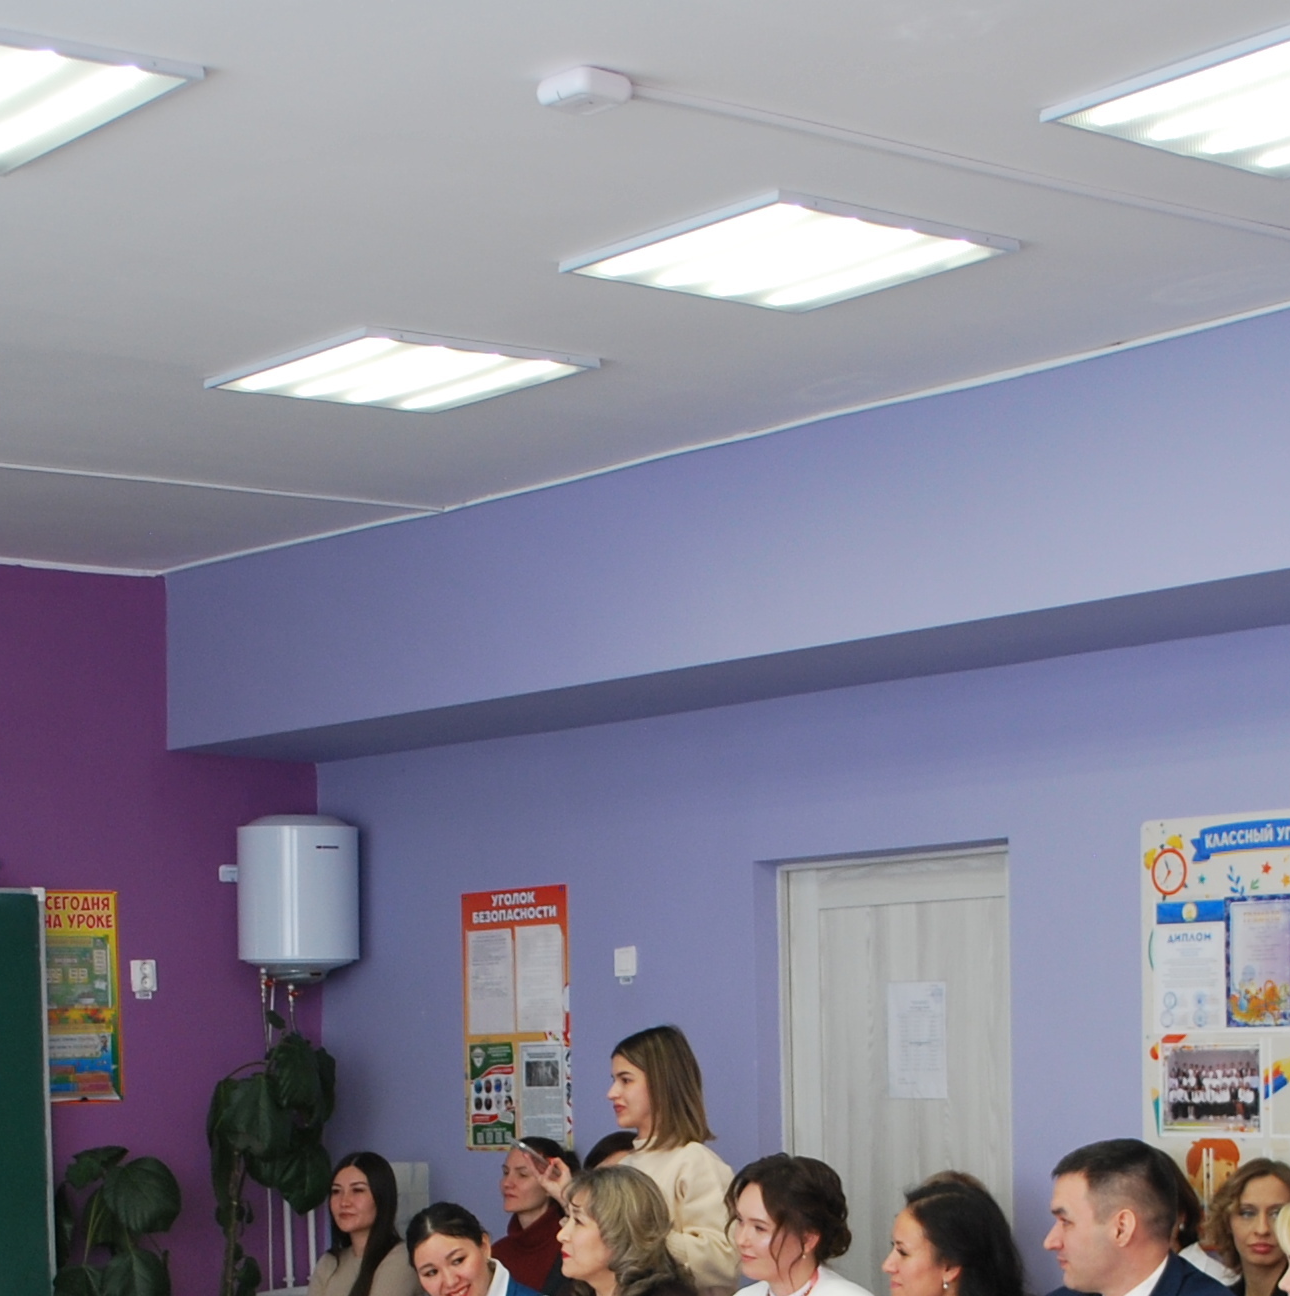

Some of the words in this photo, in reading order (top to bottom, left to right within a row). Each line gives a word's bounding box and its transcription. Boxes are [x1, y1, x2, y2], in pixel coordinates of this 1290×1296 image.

[1204, 824, 1273, 849] КЛАССНЫЙ
[45, 895, 110, 912] СЕГОДНЯ
[491, 891, 537, 907] УГОЛОК
[67, 913, 113, 929] УРОКЕ
[472, 904, 557, 924] БЕЗОПАСНОСТИ
[1167, 931, 1212, 944] ДИПЛОМ
